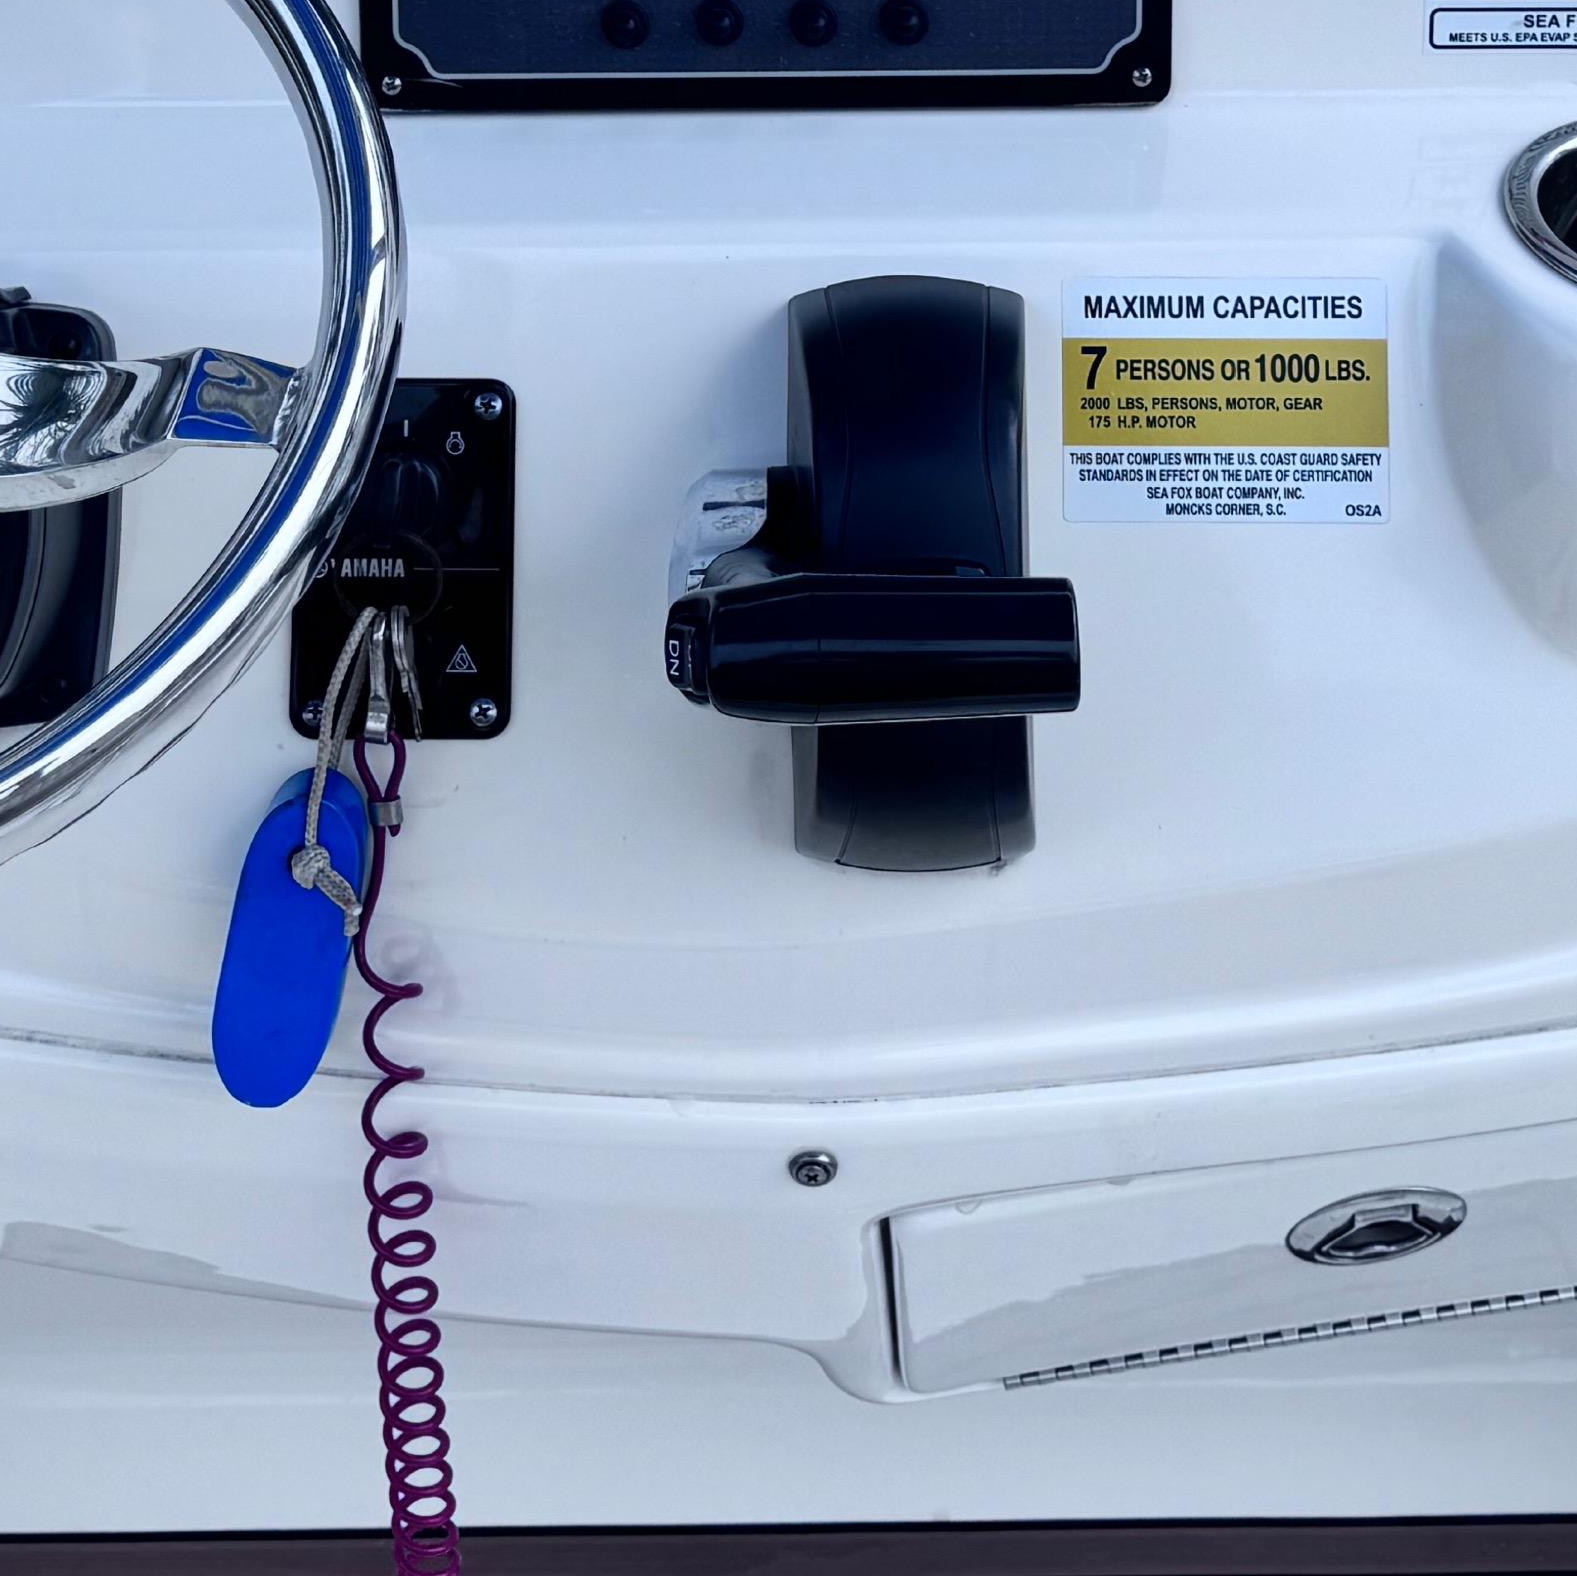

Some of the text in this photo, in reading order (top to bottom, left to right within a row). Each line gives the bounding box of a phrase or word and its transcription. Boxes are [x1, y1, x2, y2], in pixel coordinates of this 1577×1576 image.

[1523, 14, 1560, 28] SEA
[1448, 32, 1487, 42] MEETS
[1490, 32, 1512, 42] U.S.
[1515, 32, 1538, 42] EPA
[1540, 32, 1570, 42] EVAP
[1084, 295, 1362, 319] MAXIMUM CAPACITIES
[1080, 345, 1370, 390] 7 PERSONS OR 1000 LBS.
[1080, 396, 1323, 412] 2000 LBS, PERSONS, MOTOR, GEAR
[1088, 415, 1196, 429] 175 H.P. MOTOR
[1069, 452, 1382, 466] THIS BOAT COMPLIES WITH THE U.S. COAST GUARD SAFETY
[1078, 468, 1372, 482] STANDARDS IN EFFECT ON THE DATE OF CERTIFICATION
[1146, 486, 1305, 501] SEA FOX BOAT COMPANY, INC.
[1165, 502, 1286, 516] MONCKS CORNER, S.C.
[1345, 504, 1382, 517] OS2A
[668, 639, 680, 676] DN
